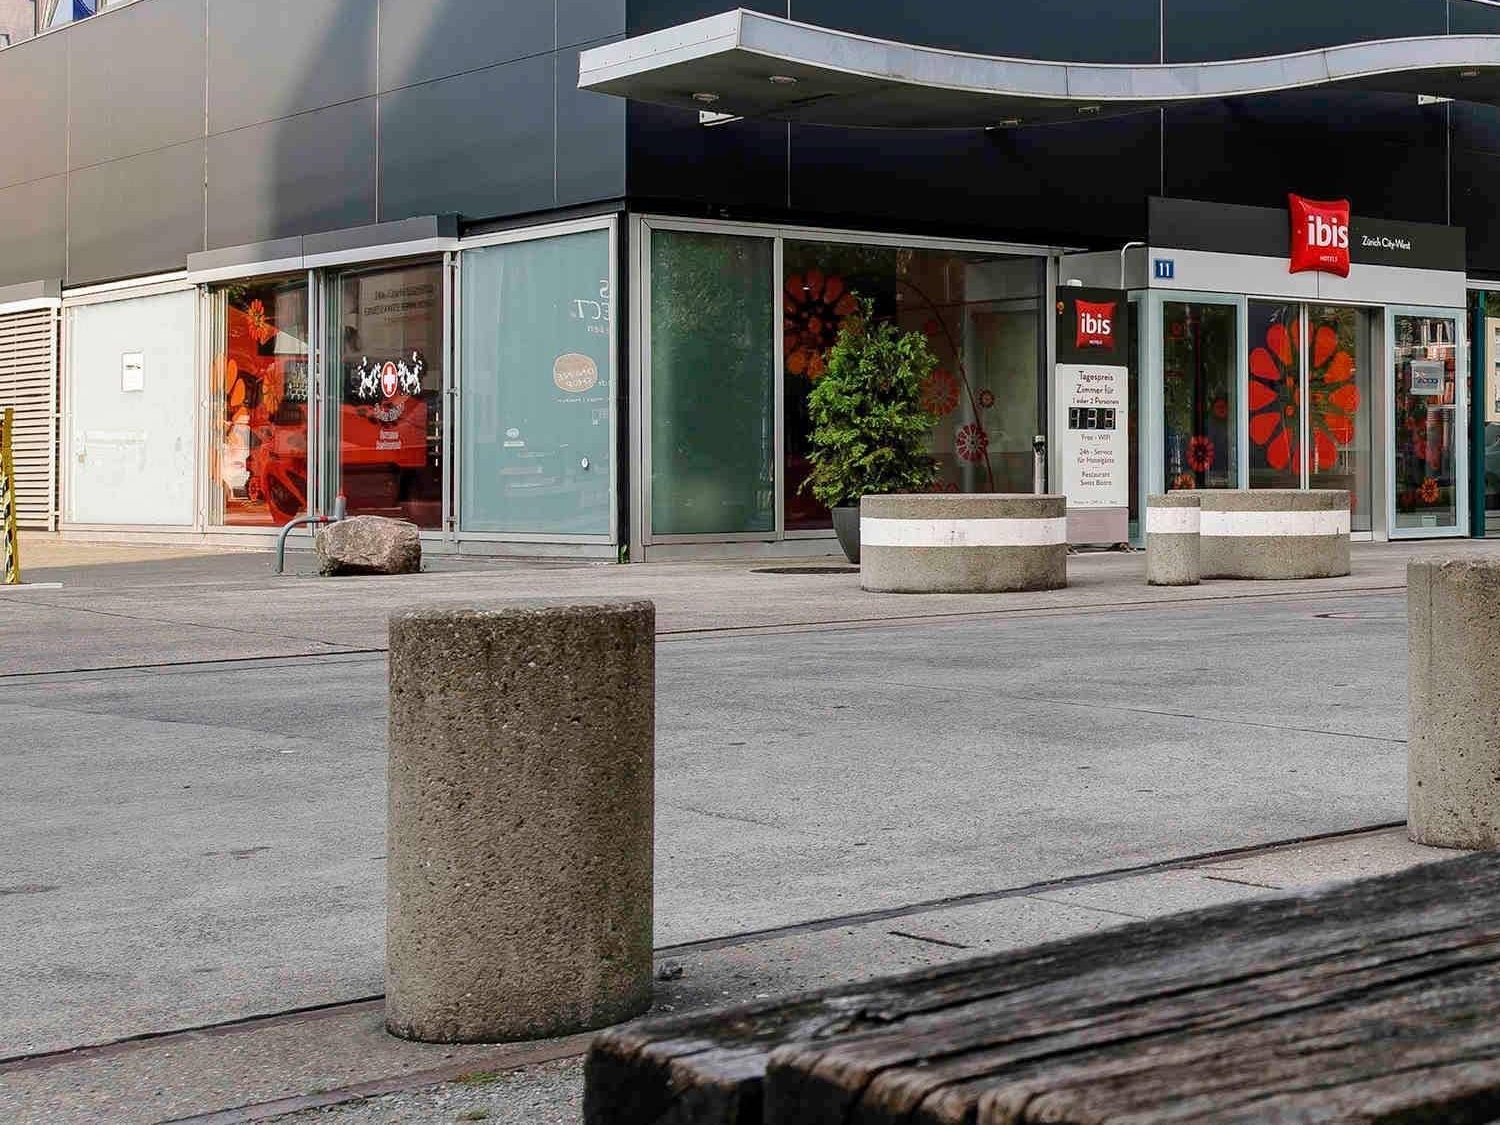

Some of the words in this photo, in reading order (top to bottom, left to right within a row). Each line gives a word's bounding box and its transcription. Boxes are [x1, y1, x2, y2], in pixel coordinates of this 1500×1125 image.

[1307, 215, 1349, 249] ibis
[1159, 262, 1170, 277] 11
[1081, 312, 1111, 335] ibis
[1078, 370, 1114, 383] Tagespreis
[1076, 383, 1103, 394] Zimmer
